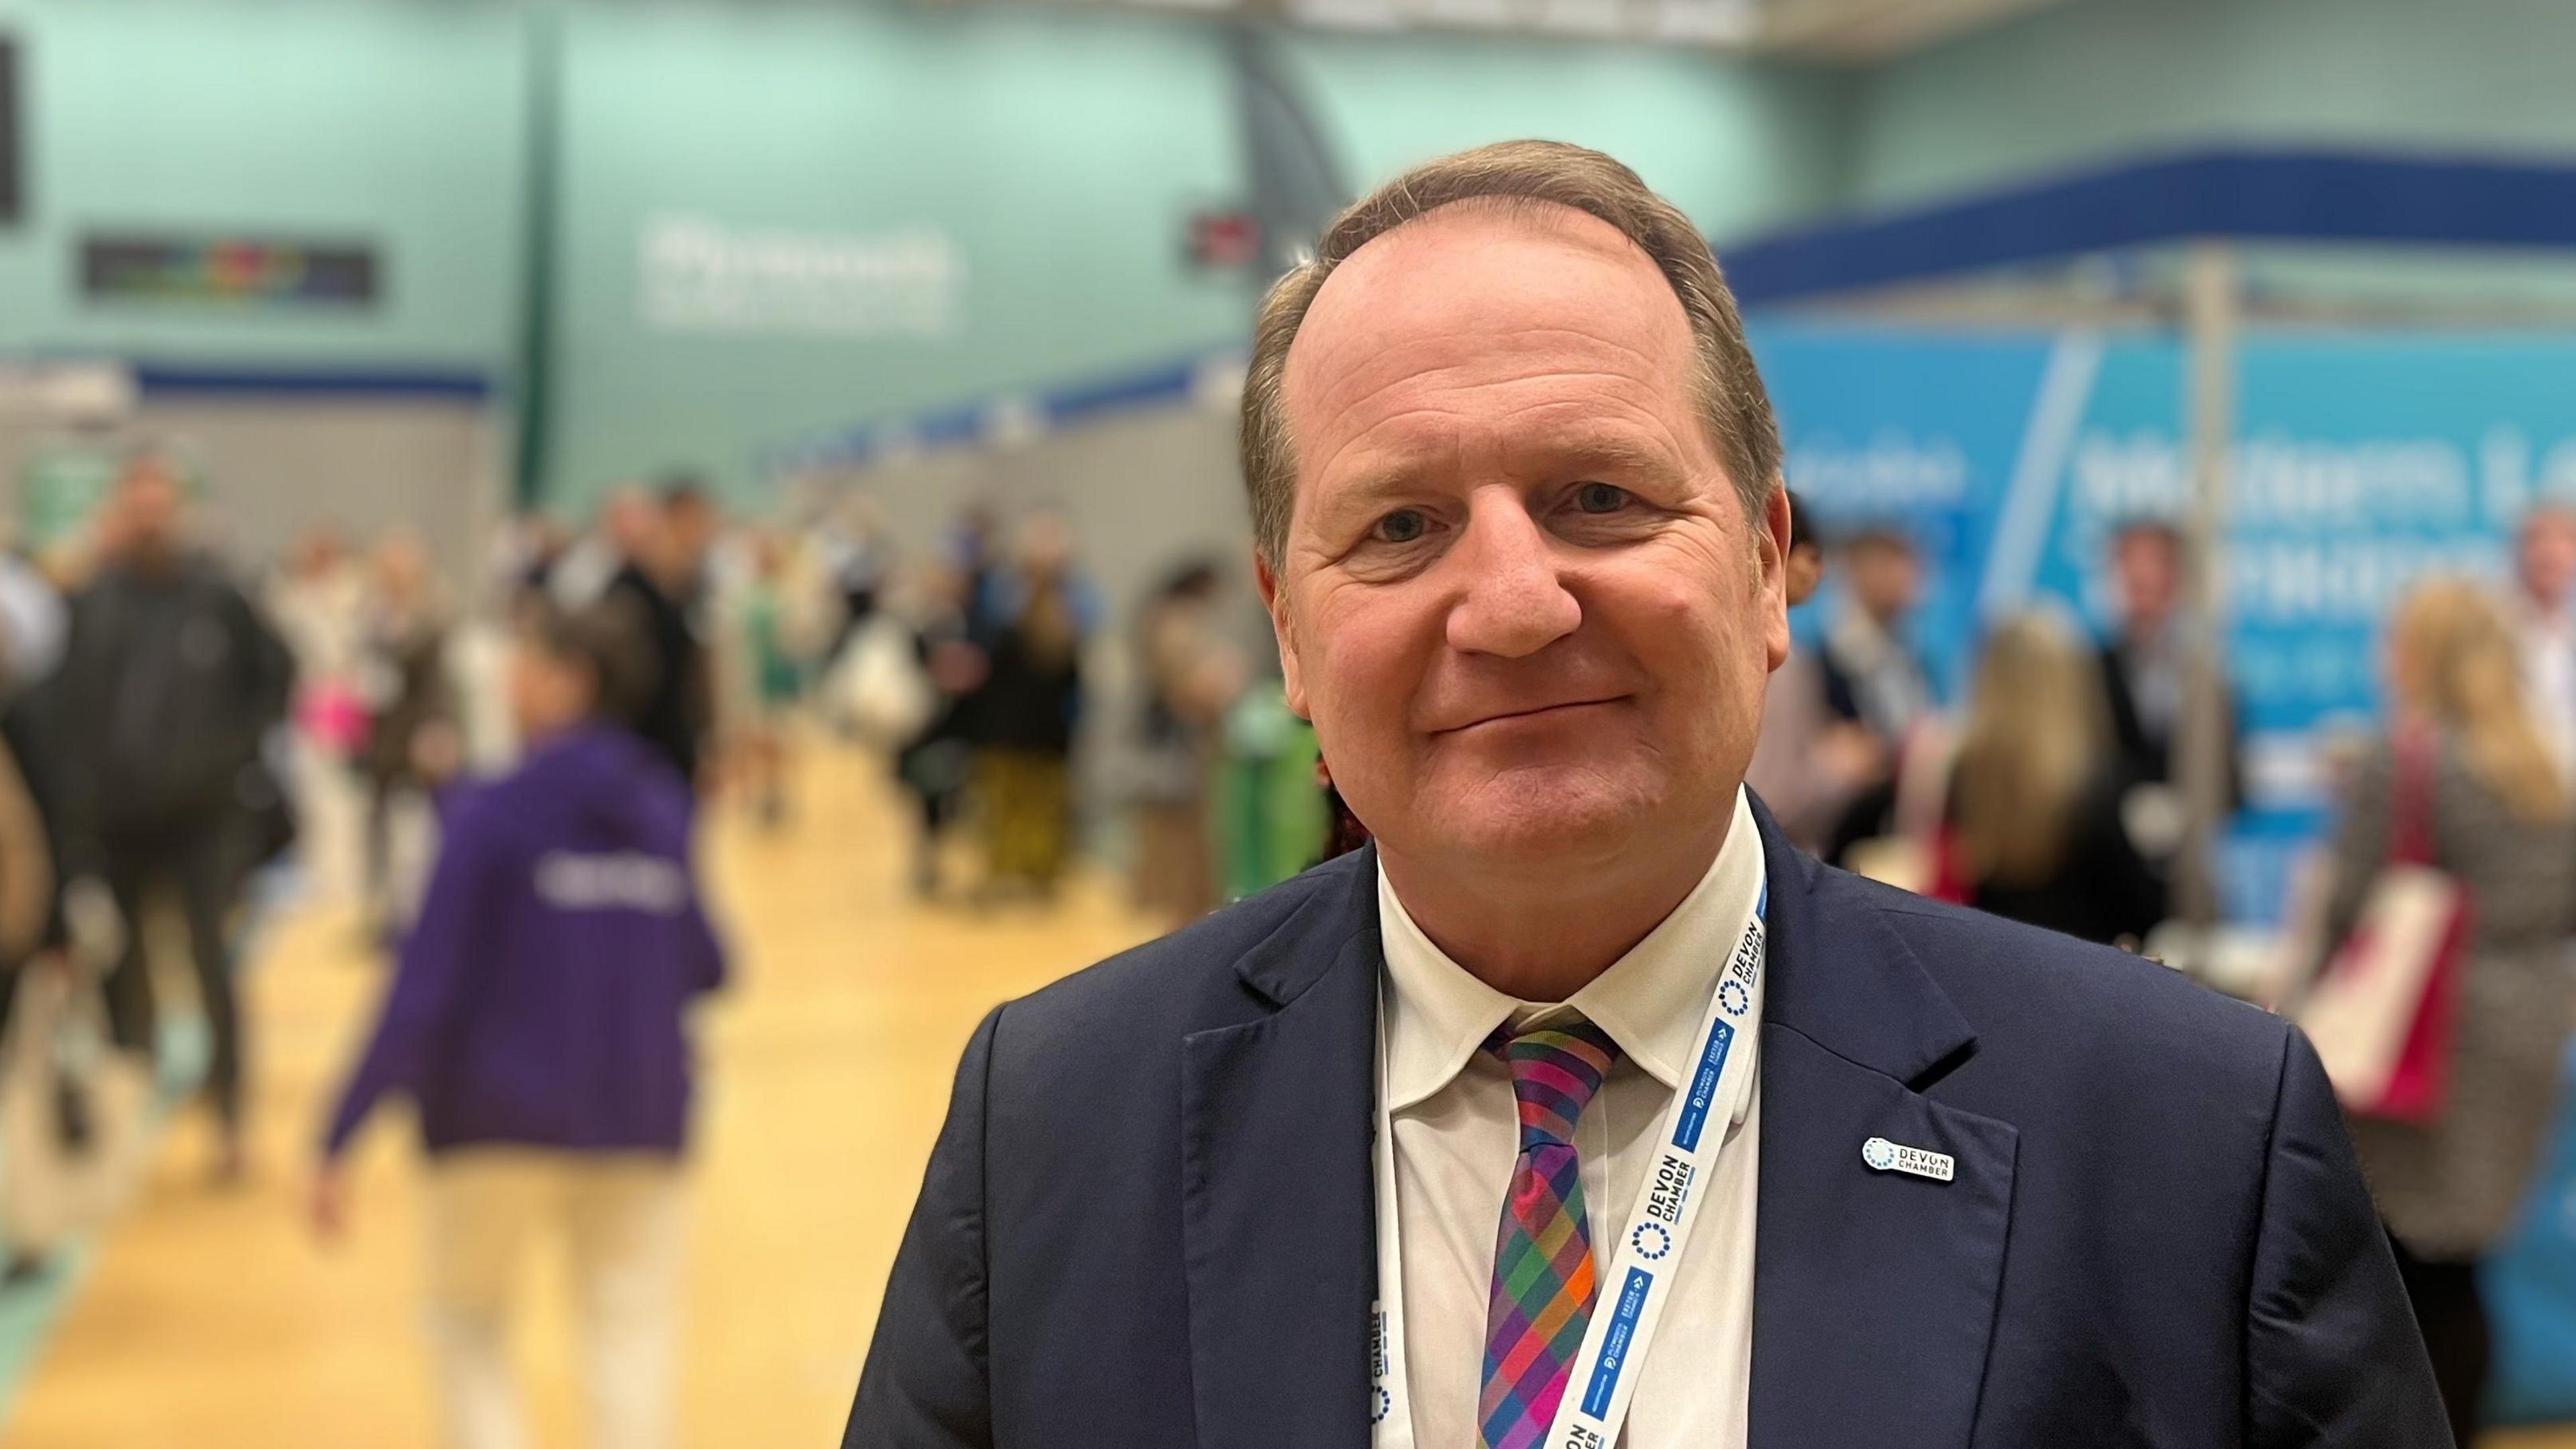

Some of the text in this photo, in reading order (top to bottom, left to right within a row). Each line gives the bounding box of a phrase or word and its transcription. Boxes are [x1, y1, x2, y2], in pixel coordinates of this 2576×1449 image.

[1732, 922, 1757, 978] DEVON
[1742, 932, 1763, 985] CHAMBER
[1898, 1160, 1948, 1177] CHAMBER
[1900, 1148, 1949, 1169] DEVON
[1647, 1155, 1678, 1218] DEVON
[1662, 1162, 1690, 1222] CHAMBER
